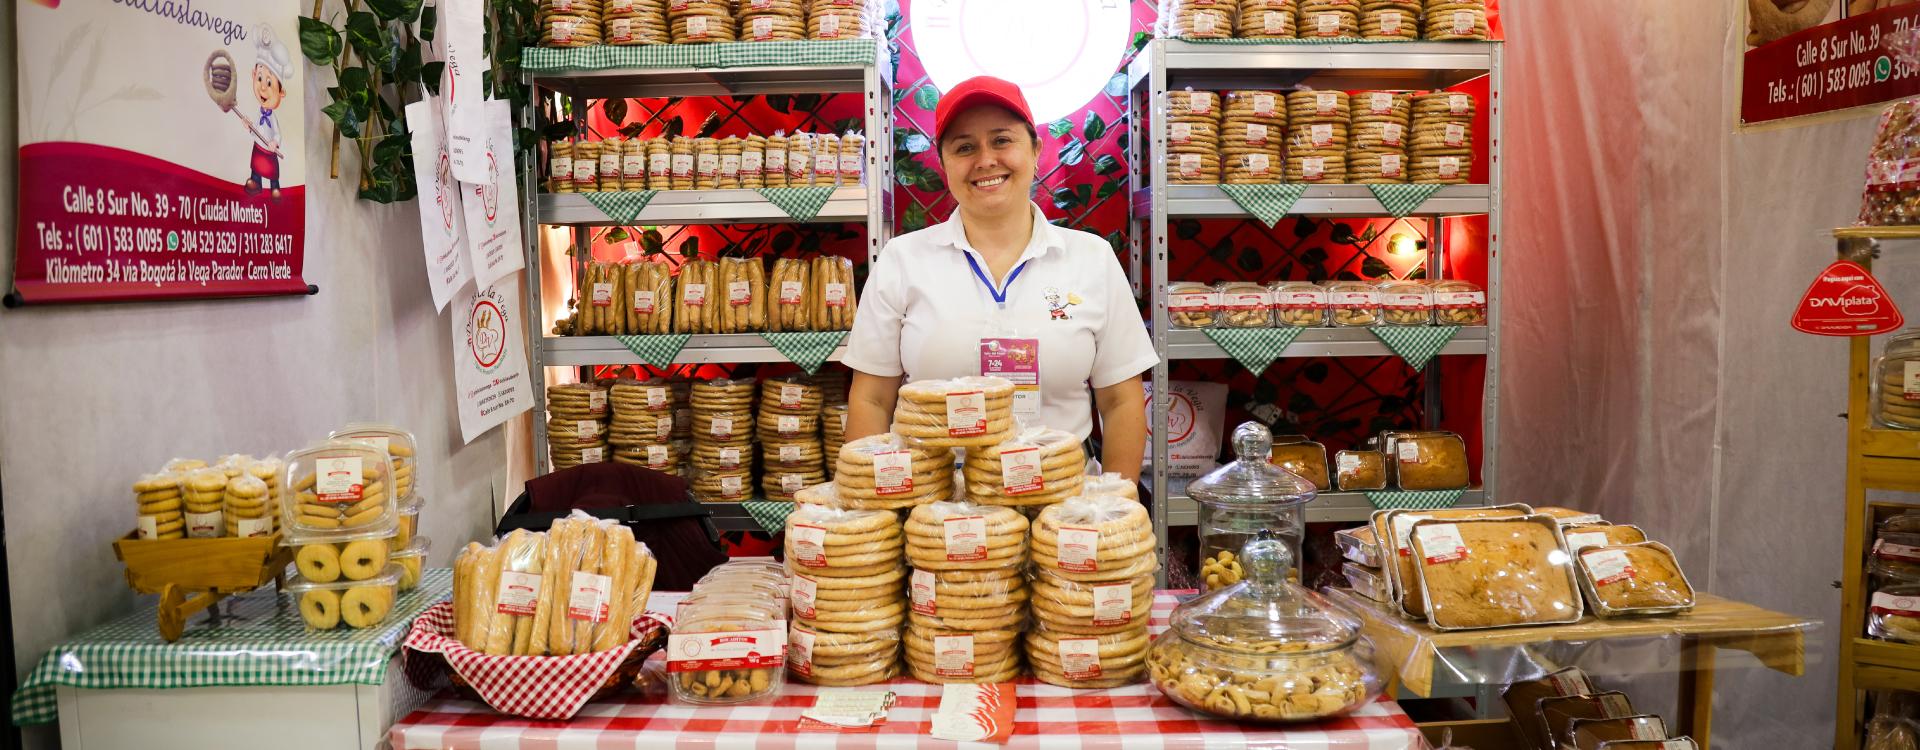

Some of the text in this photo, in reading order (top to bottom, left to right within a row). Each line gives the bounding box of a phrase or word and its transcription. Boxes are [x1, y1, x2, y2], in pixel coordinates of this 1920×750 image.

[1796, 40, 1818, 67] Calle
[1819, 38, 1828, 62] 8
[1830, 35, 1848, 61] Sur
[1850, 30, 1867, 56] No.
[1868, 23, 1880, 51] 39
[1826, 66, 1846, 93] 583
[1848, 60, 1871, 89] 0095
[63, 185, 95, 214] Calle
[96, 187, 105, 215] 8
[107, 189, 128, 216] Sur
[131, 191, 153, 218] No.
[155, 193, 169, 218] 39
[178, 195, 191, 220] 70
[114, 226, 134, 252] 583
[136, 227, 163, 253] 0095
[181, 229, 198, 253] 304
[199, 230, 215, 254] 529
[216, 231, 237, 254] 2629
[244, 232, 259, 254] 311
[260, 233, 273, 255] 283
[275, 234, 293, 255] 6417
[45, 257, 291, 288] Kilómetro 34 vía Bogotá la Vega Parador Cerro Verde
